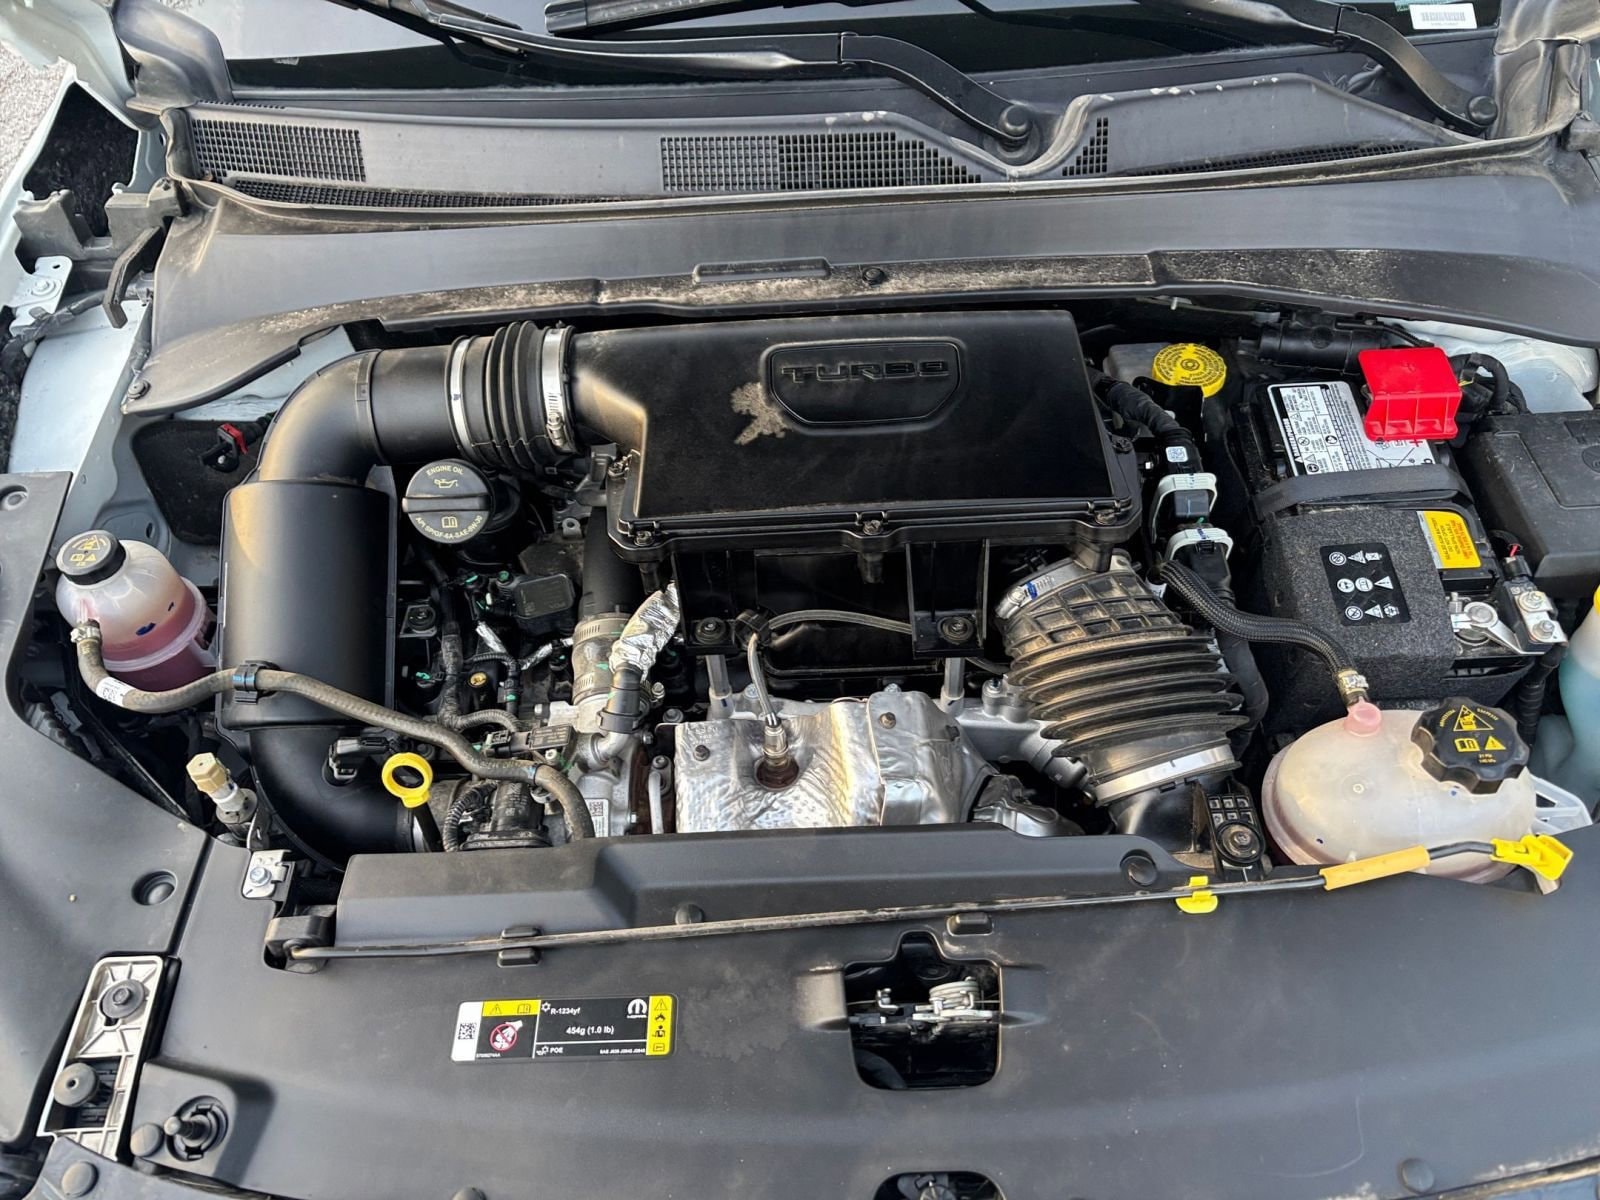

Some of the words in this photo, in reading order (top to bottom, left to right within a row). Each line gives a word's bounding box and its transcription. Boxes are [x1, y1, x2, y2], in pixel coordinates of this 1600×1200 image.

[425, 465, 452, 476] ENGINE
[452, 466, 464, 475] OIL
[550, 1007, 581, 1015] R-1234yf
[566, 1026, 586, 1035] 454g
[587, 1026, 602, 1035] (1.0
[603, 1025, 615, 1035] lb)
